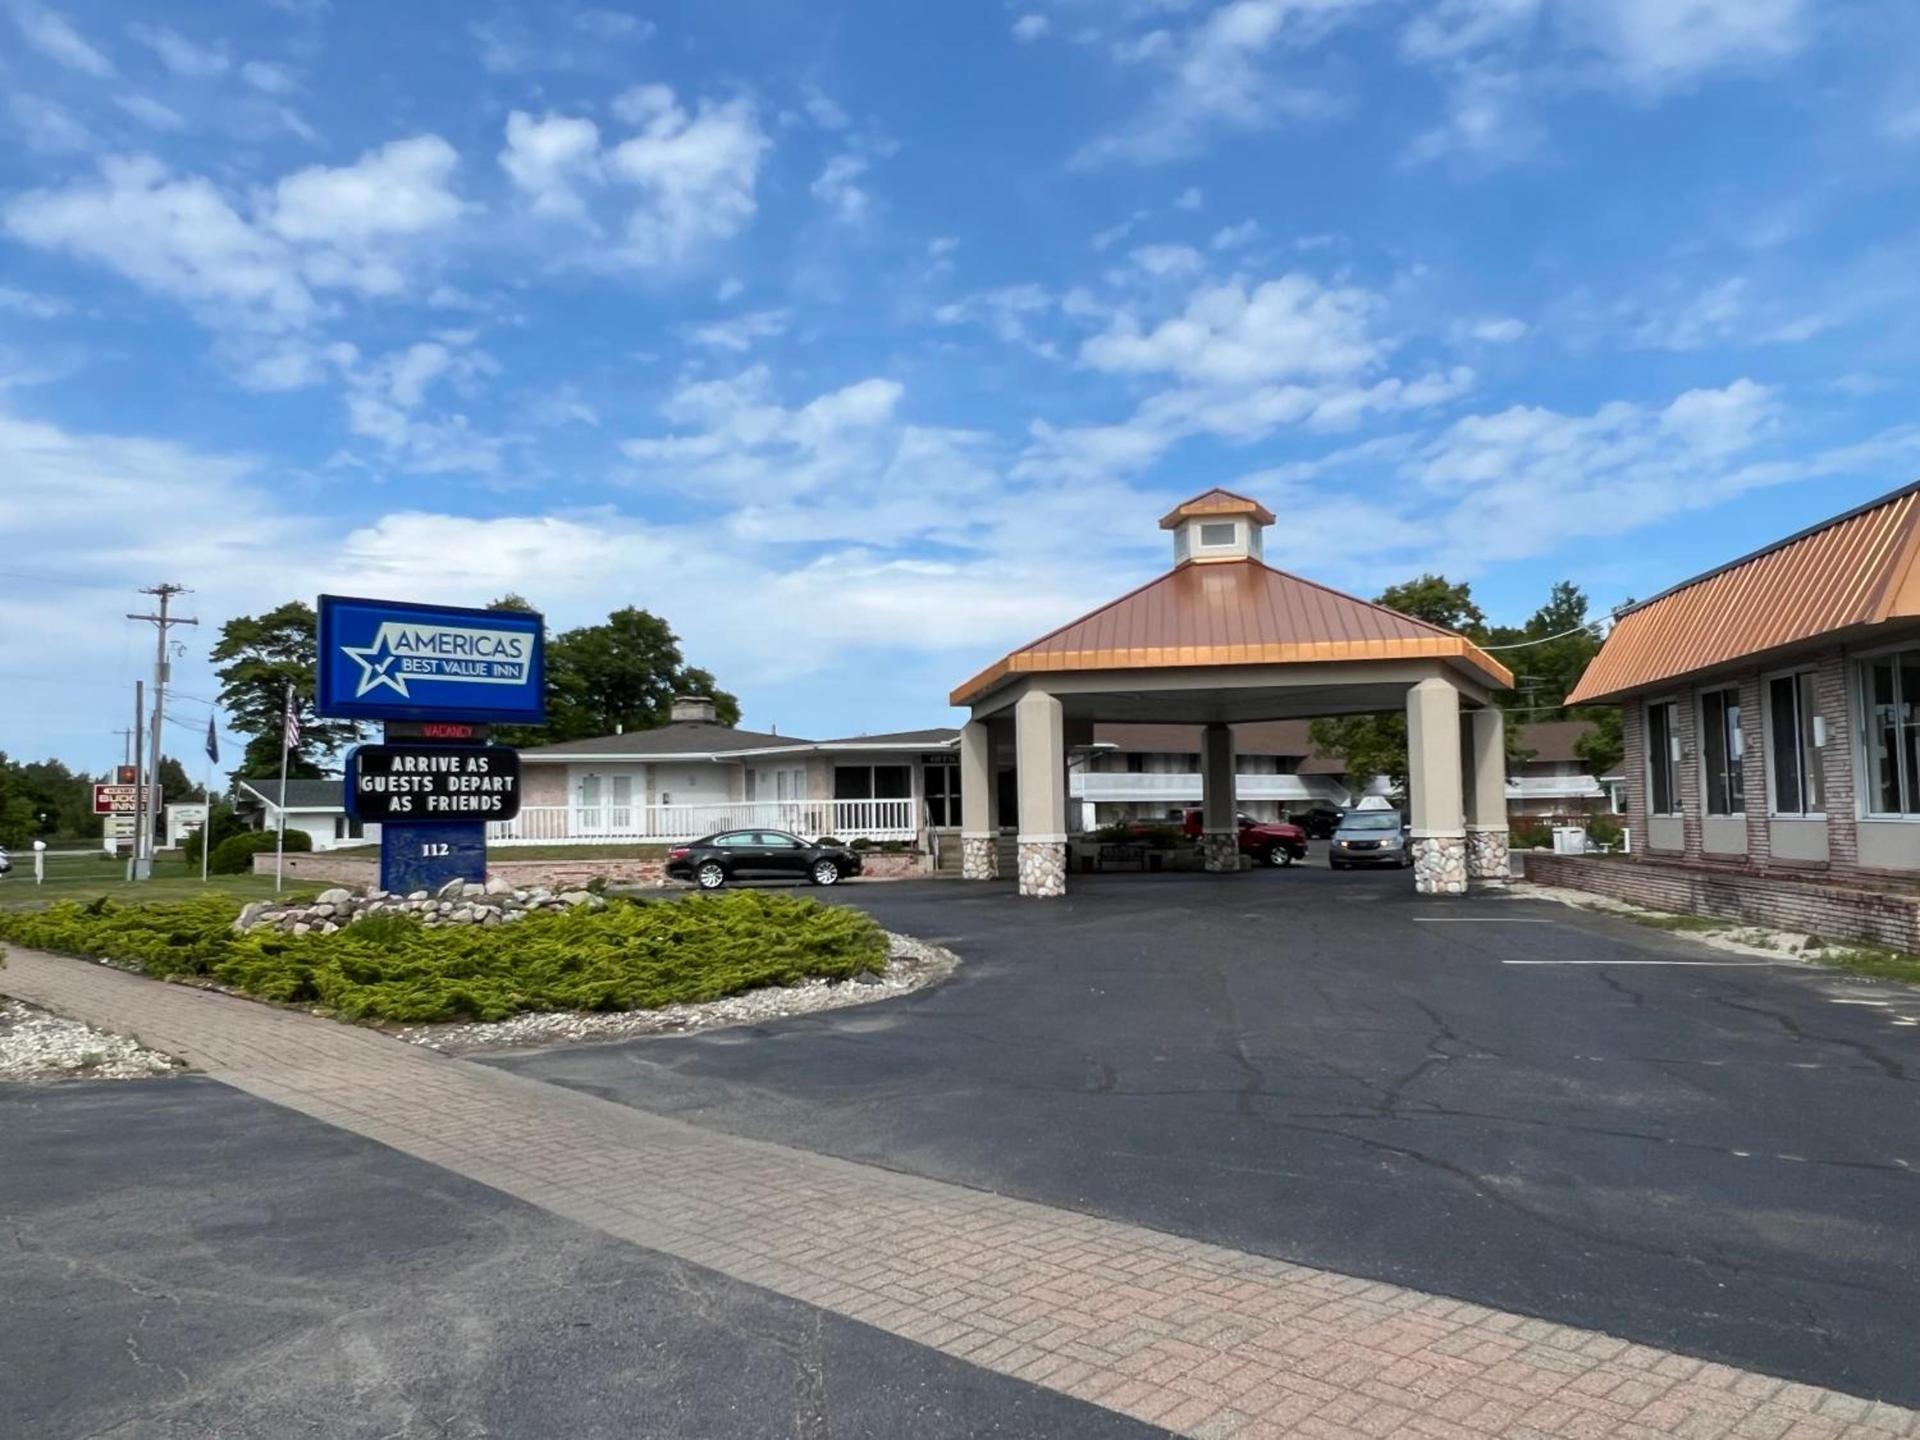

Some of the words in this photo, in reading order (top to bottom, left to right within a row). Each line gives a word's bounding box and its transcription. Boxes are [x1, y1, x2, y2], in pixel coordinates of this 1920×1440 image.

[395, 630, 523, 659] AMERICAS
[402, 659, 439, 673] BEST
[441, 661, 488, 676] VALUE
[493, 663, 520, 678] INN
[422, 724, 473, 738] VACANCY
[391, 756, 461, 772] ARRIVE
[466, 757, 489, 772] AS
[361, 776, 434, 792] GUESTS
[447, 776, 514, 792] DEPART
[389, 796, 413, 812] AS
[426, 795, 502, 811] FRIENDS
[422, 843, 450, 857] 112
